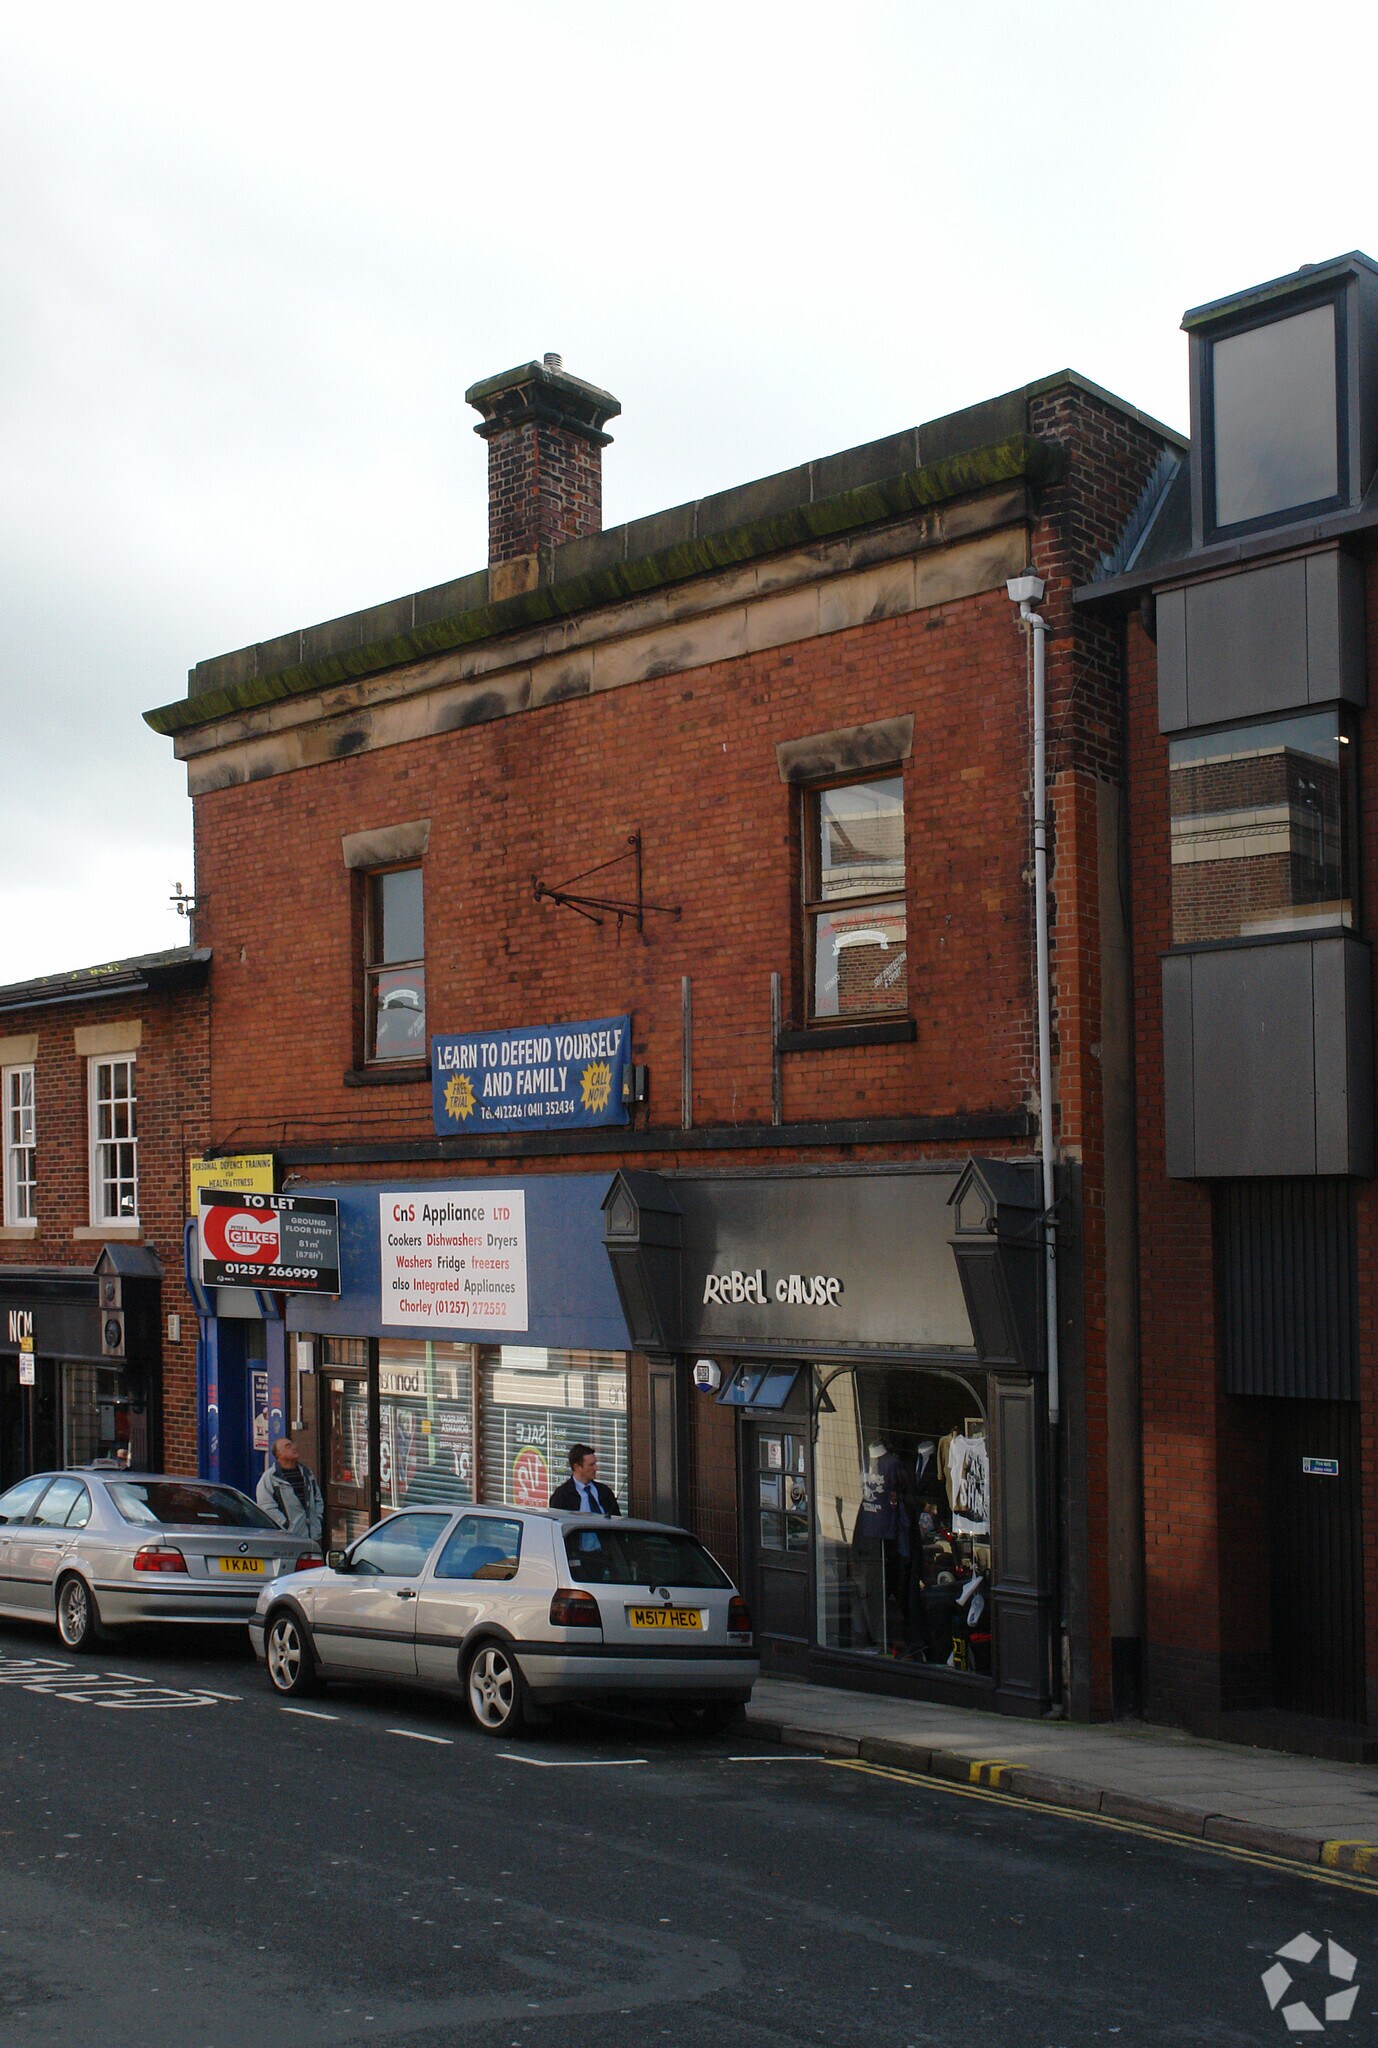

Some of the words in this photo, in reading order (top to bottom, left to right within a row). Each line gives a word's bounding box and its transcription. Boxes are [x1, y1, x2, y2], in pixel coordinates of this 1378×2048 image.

[438, 1044, 477, 1070] LEARN
[481, 1043, 498, 1067] TO
[502, 1037, 551, 1066] DEFEND
[555, 1029, 622, 1061] YOURSELF
[483, 1072, 511, 1097] AND
[516, 1067, 568, 1095] FAMILY
[591, 1071, 608, 1086] CALL
[453, 1082, 467, 1096] FREE
[587, 1088, 606, 1103] NOW
[450, 1096, 469, 1109] TRIAL
[545, 1100, 575, 1115] 352434
[192, 1161, 217, 1171] PERSONAL
[220, 1160, 243, 1170] DEFENCE
[245, 1160, 270, 1169] TRAINING
[209, 1179, 229, 1188] HEALTH
[233, 1178, 254, 1187] FITNESS
[243, 1195, 265, 1207] TO
[270, 1198, 295, 1210] LET
[291, 1217, 326, 1226] GROUND
[393, 1204, 415, 1222] CnS
[423, 1203, 485, 1226] Appliance
[493, 1207, 510, 1221] LTD
[230, 1231, 277, 1245] GILKES
[285, 1225, 311, 1234] FLOOR
[313, 1227, 332, 1236] UNIT
[388, 1233, 422, 1246] Cookers
[427, 1233, 482, 1246] Dishwashers
[487, 1234, 518, 1249] Dryers
[225, 1263, 264, 1275] 01257
[268, 1267, 318, 1279] 266999
[396, 1255, 433, 1268] Washers
[438, 1256, 466, 1272] Fridge
[471, 1256, 510, 1270] freezers
[392, 1277, 410, 1290] also
[413, 1278, 460, 1294] Integrated
[464, 1279, 515, 1295] Appliances
[400, 1299, 432, 1316] Chorley
[435, 1300, 470, 1317] (01257)
[635, 1611, 666, 1625] M517
[670, 1612, 697, 1626] HEC
